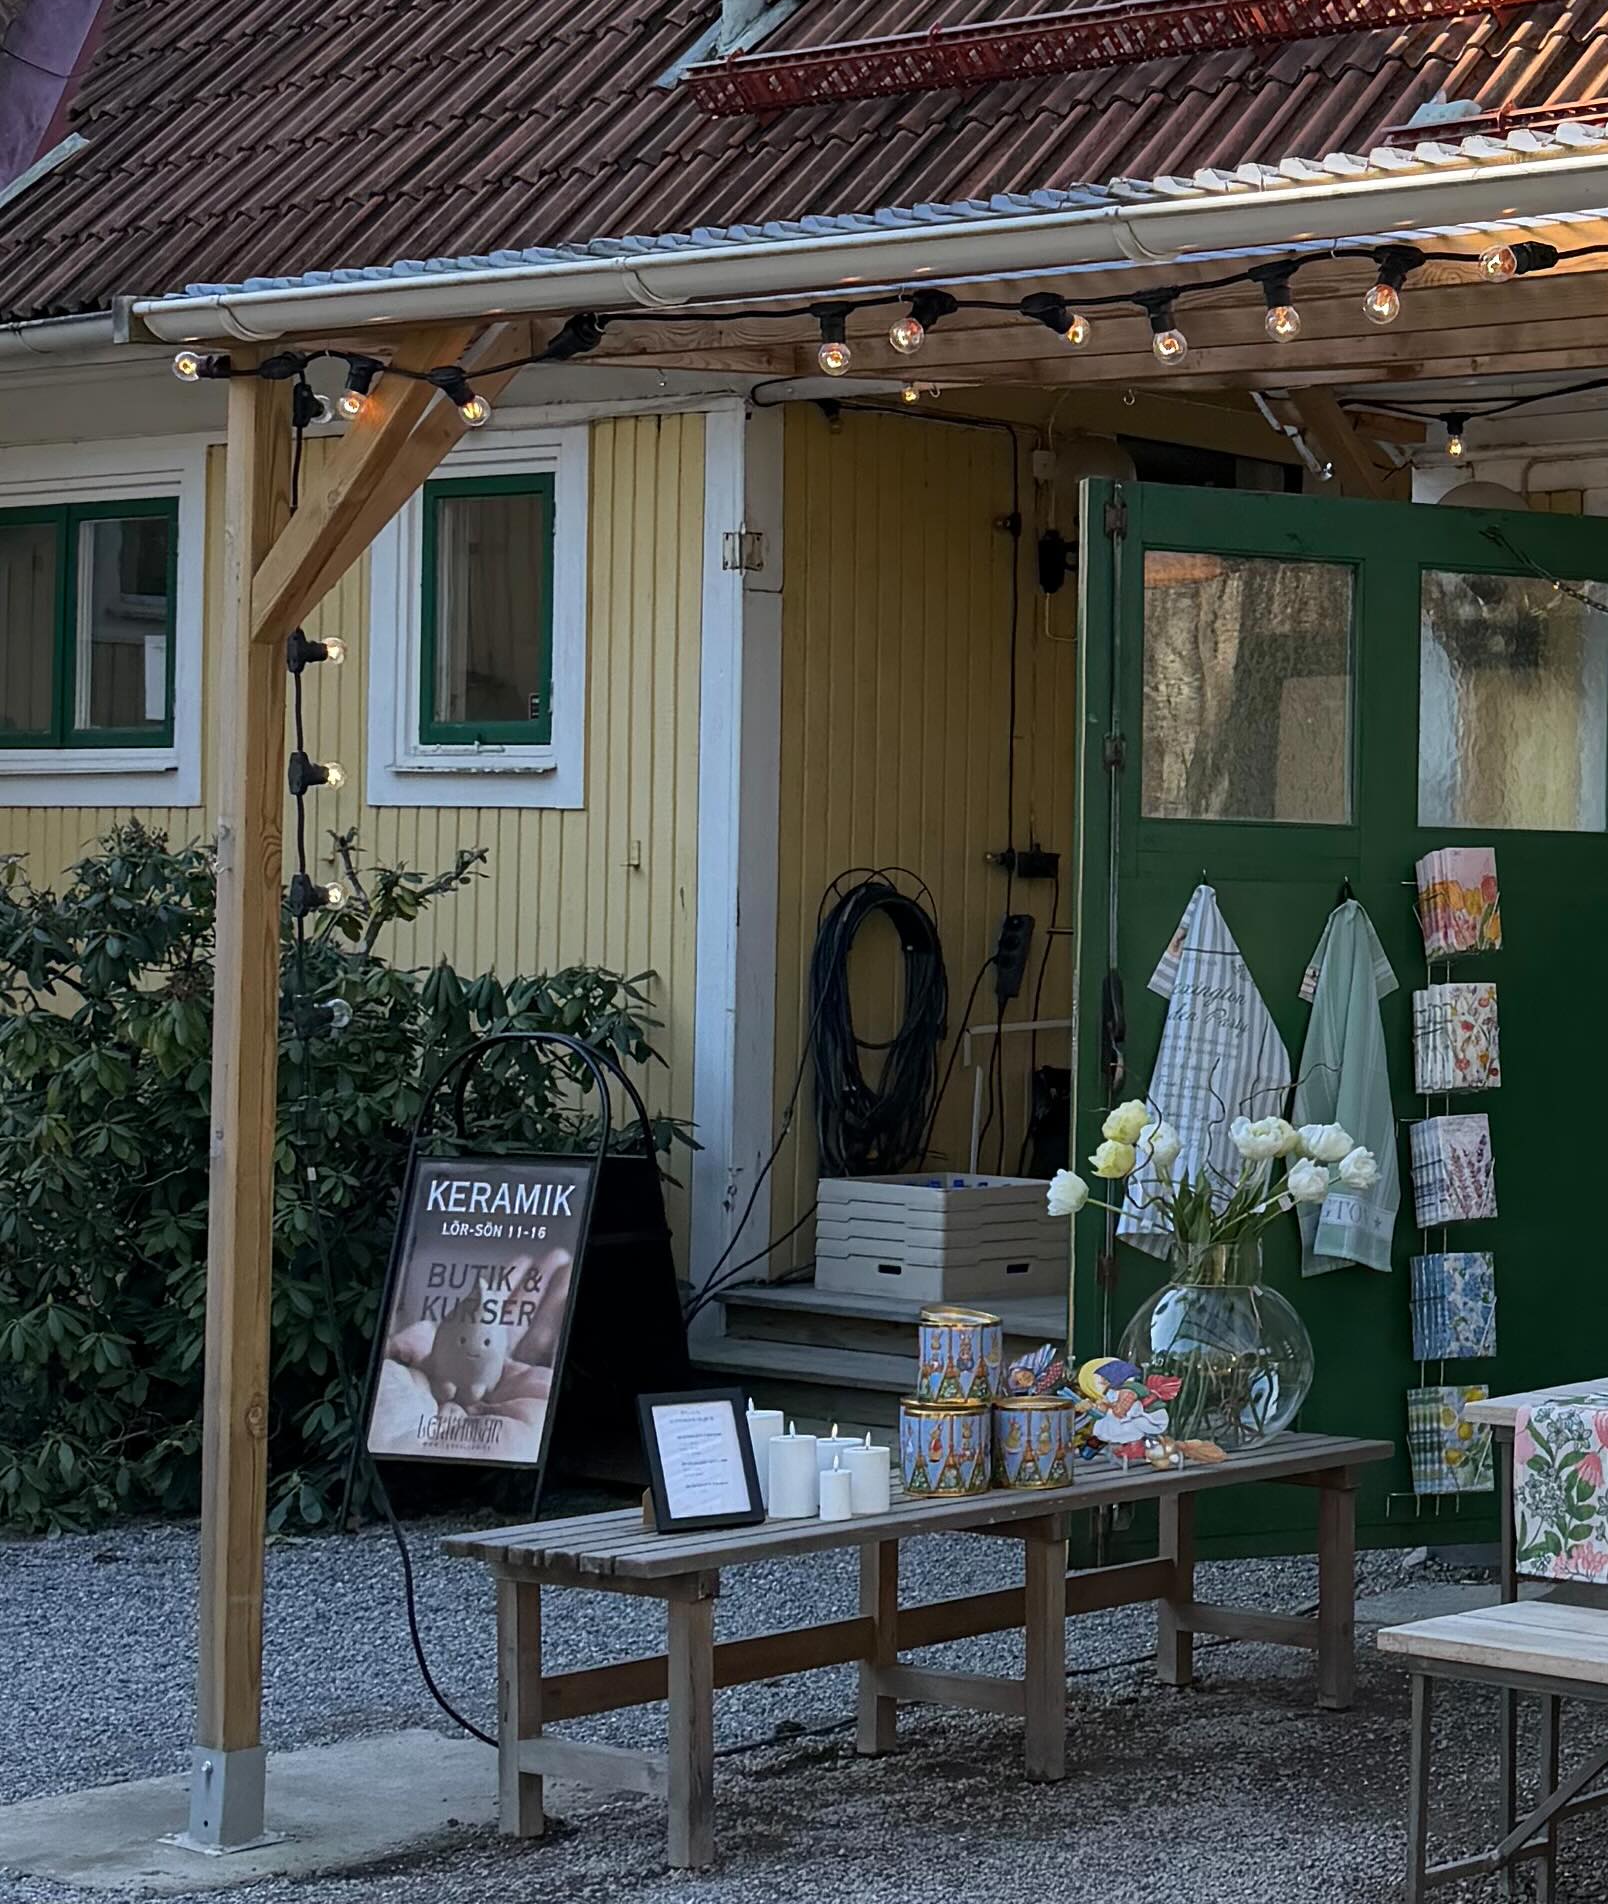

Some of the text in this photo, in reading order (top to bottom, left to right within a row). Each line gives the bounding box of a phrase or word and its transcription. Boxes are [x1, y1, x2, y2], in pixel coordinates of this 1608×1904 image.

[426, 1180, 577, 1217] KERAMIK
[441, 1220, 548, 1239] LÖR-SÖN 11-16
[427, 1262, 543, 1294] BUTIK &
[420, 1295, 537, 1328] KURSER
